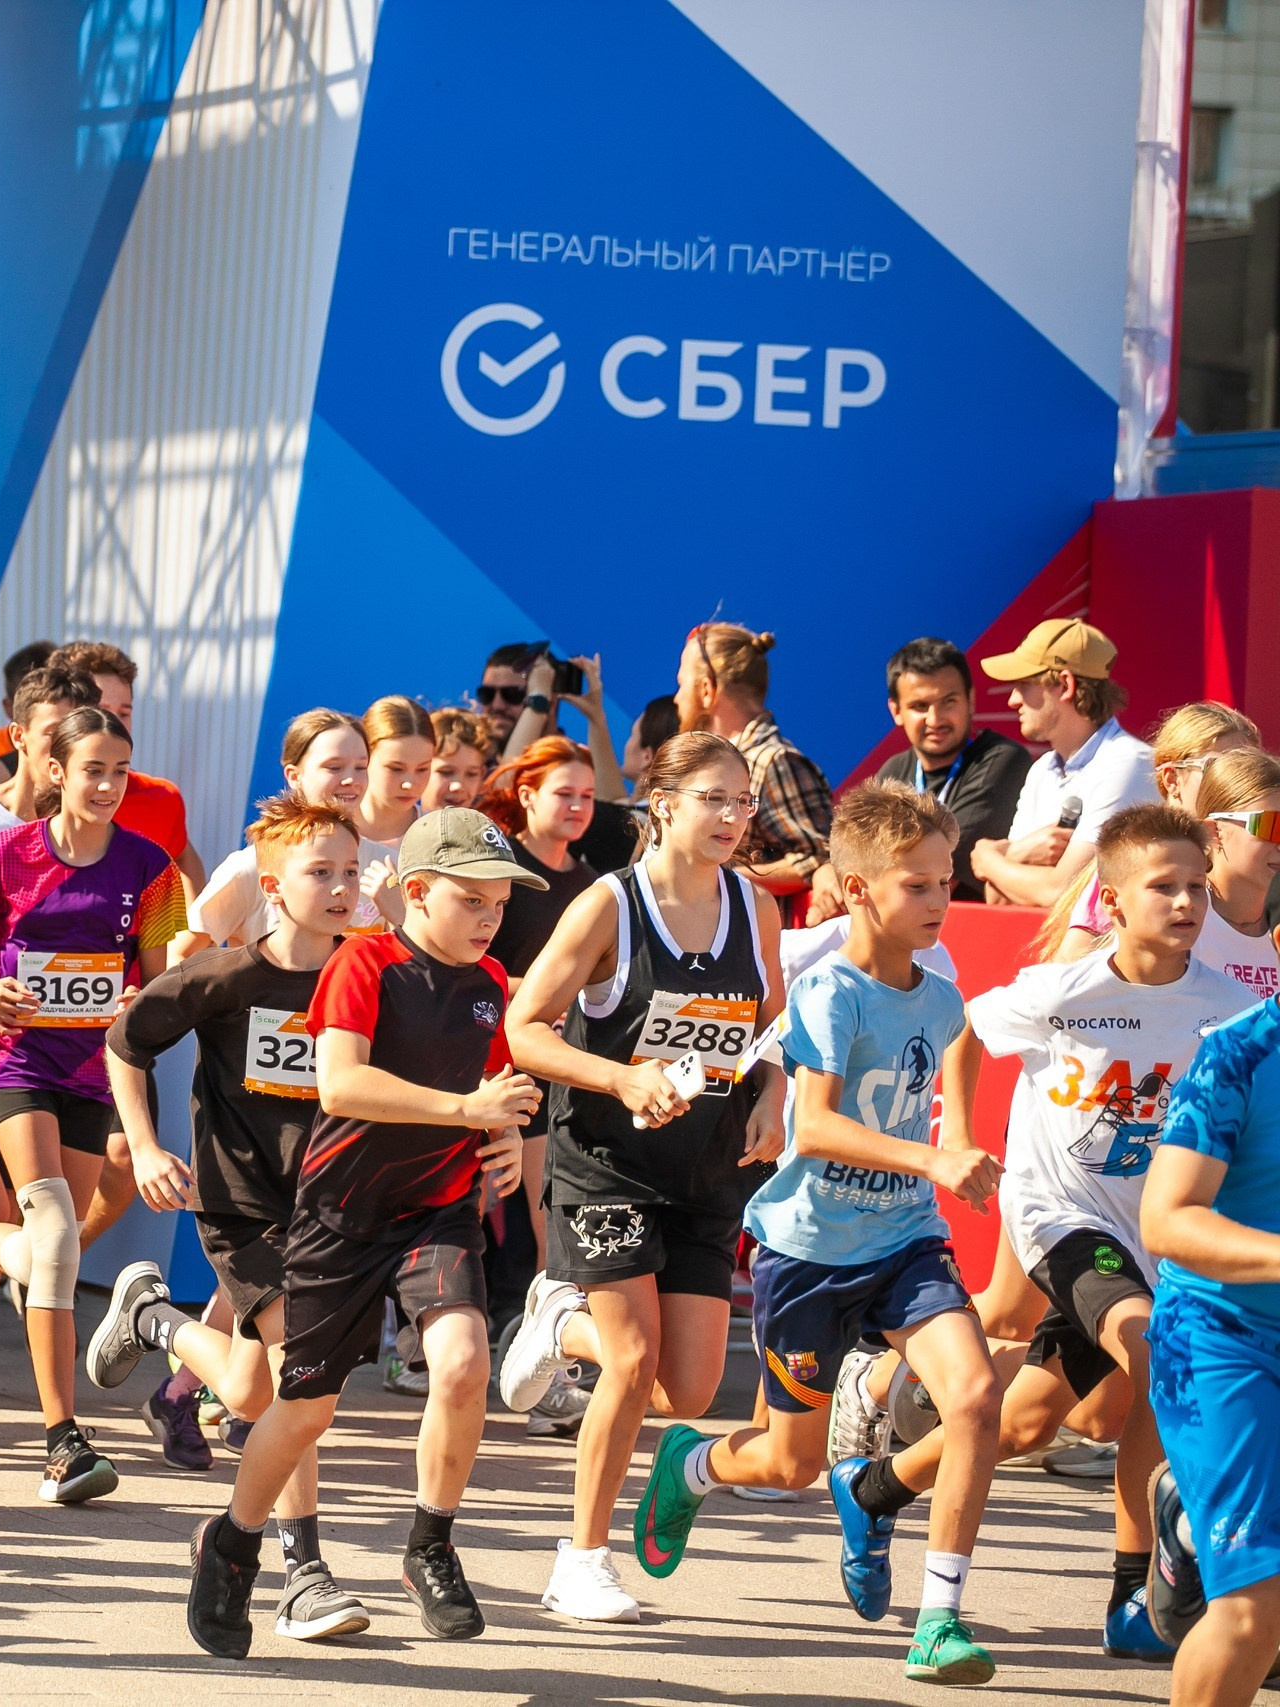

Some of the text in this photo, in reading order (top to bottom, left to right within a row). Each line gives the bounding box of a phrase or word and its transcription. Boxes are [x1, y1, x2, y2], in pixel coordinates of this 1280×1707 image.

[448, 227, 716, 272] ГЕНЕРАЛЬНЫЙ
[599, 335, 887, 429] СБЕР
[27, 975, 114, 1005] 3169
[644, 1018, 747, 1056] 3288
[1067, 1017, 1141, 1030] РОСАТОМ
